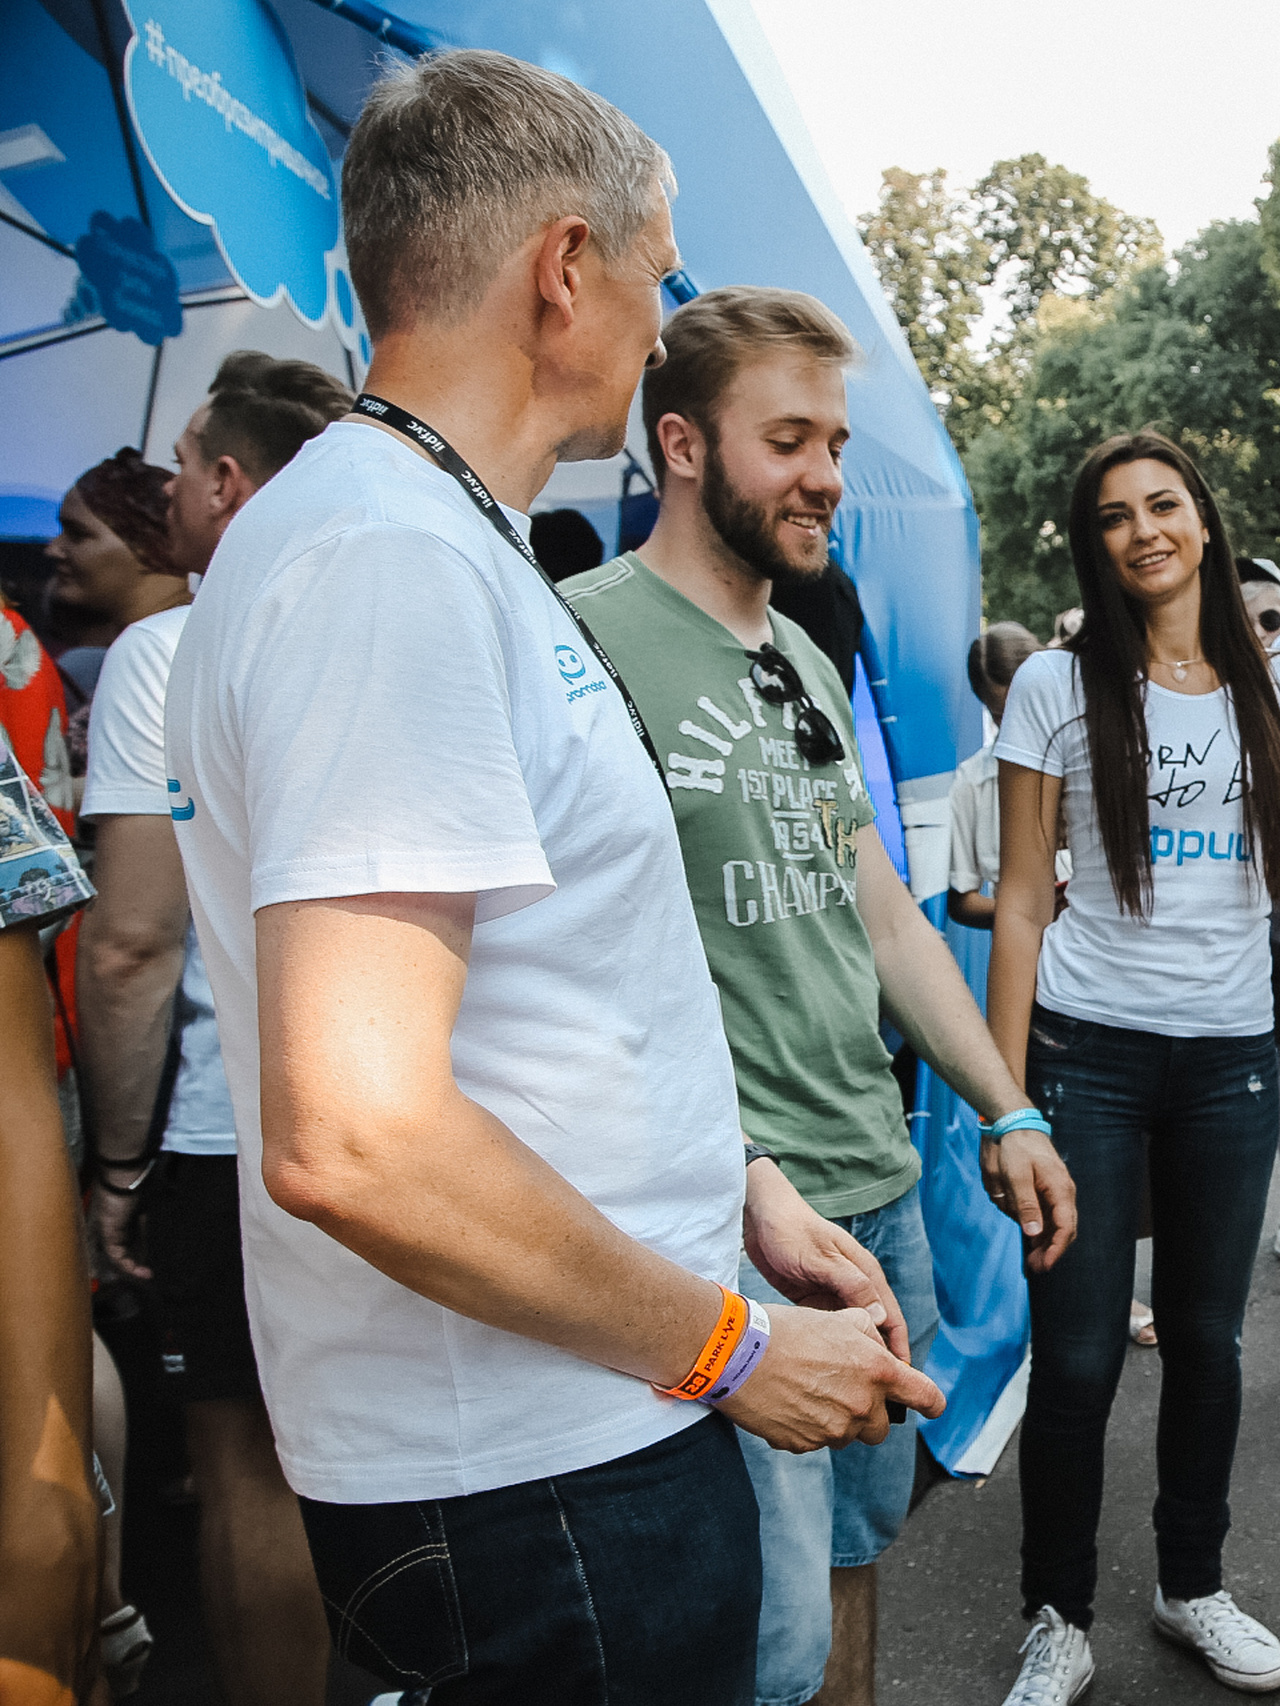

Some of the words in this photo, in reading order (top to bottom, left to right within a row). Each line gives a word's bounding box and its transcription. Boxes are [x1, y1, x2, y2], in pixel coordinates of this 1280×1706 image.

[406, 420, 446, 453] iidf.vc
[461, 470, 494, 509] iidf.vc
[684, 1375, 707, 1393] 28
[704, 1341, 725, 1372] PARK
